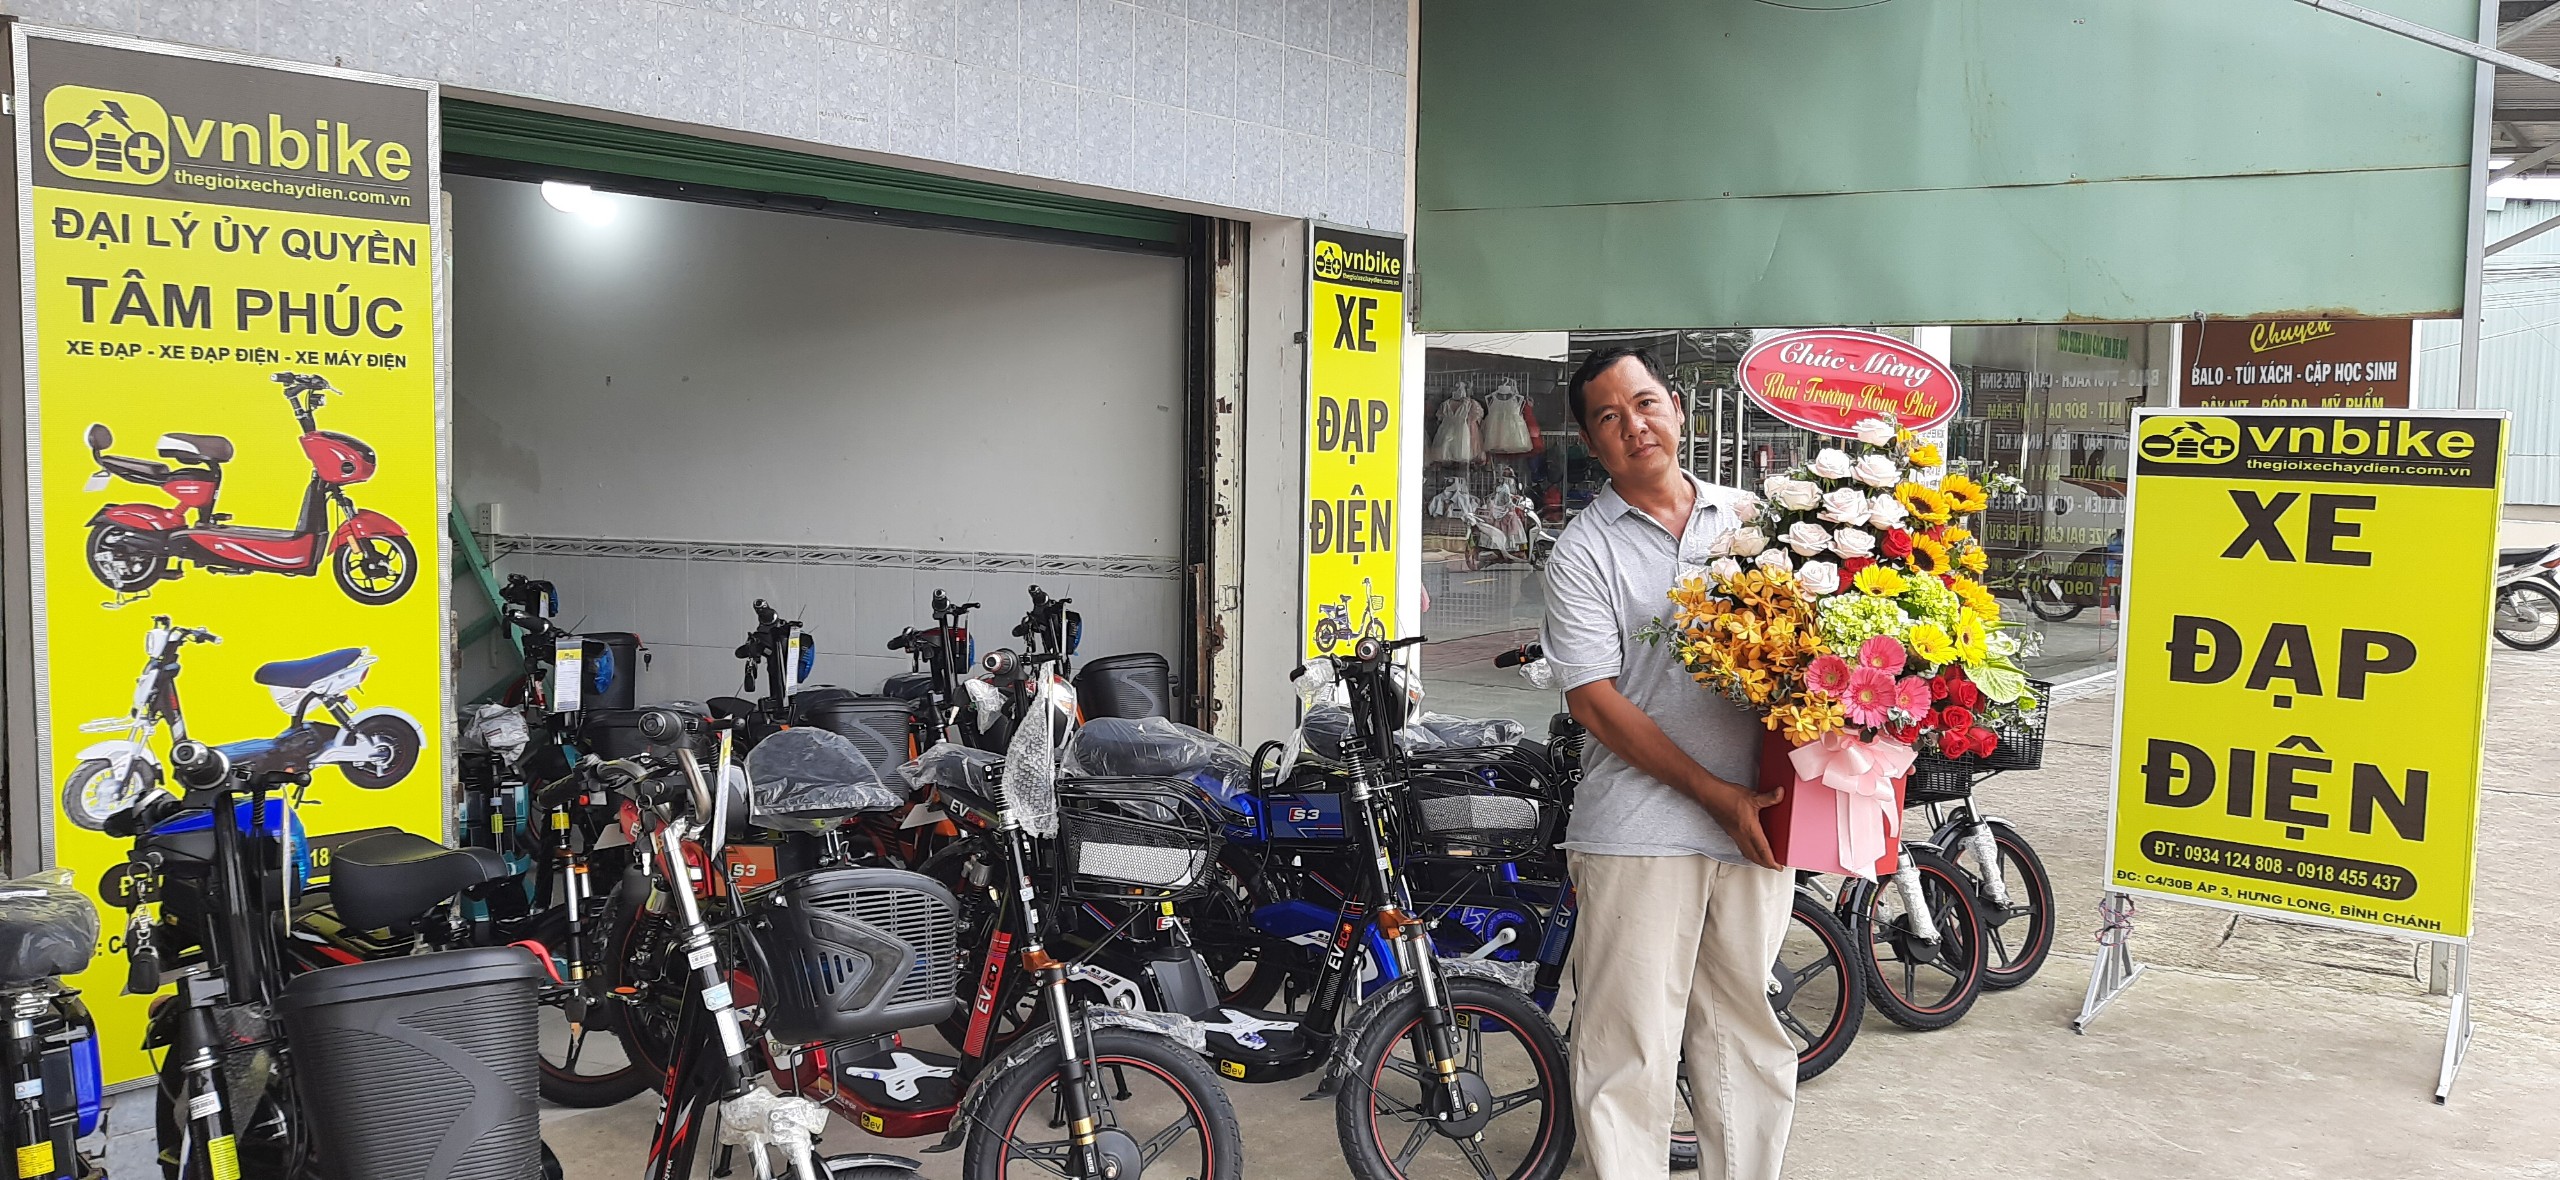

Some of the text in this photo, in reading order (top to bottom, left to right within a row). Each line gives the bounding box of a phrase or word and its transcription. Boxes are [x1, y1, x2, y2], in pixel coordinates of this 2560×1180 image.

[172, 113, 412, 182] vnbike
[174, 169, 411, 207] thegioixechaydien.com.vn
[52, 207, 416, 266] ĐẠI LÝ ỦY QUYỀN
[1343, 249, 1400, 275] vnbike
[66, 268, 404, 339] TÂM PHÚC
[1333, 294, 1379, 353] XE
[66, 340, 407, 370] XE ĐẠP XE ĐẠP ĐIỆN XE MÁY ĐIỆN
[1779, 342, 1934, 388] Chúc Mừng
[2191, 360, 2398, 387] BALO TÚI XÁCH CẶP HỌC SINH
[1761, 372, 1801, 401] Khai
[1901, 389, 1939, 419] Phát
[1317, 396, 1389, 465] ĐẠP
[2247, 419, 2475, 459] vnbike
[2246, 458, 2471, 477] thegioixechaydien.com.vn
[1310, 484, 1392, 565] ĐIỆN
[2220, 489, 2377, 567] XE
[2166, 614, 2417, 709] ĐẠP
[1288, 807, 1320, 823] S3
[2141, 735, 2429, 842] ĐIỆN
[2154, 840, 2402, 892] ĐT: 0934 124 808 0918 455 437
[2116, 870, 2141, 882] ĐC:
[2145, 874, 2193, 890] C4/30B
[2221, 886, 2233, 898] 3,
[2237, 889, 2283, 904] HƯNG
[2287, 897, 2335, 915] LONG,
[2340, 905, 2378, 920] BÌNH
[2383, 913, 2441, 931] CHÁNH
